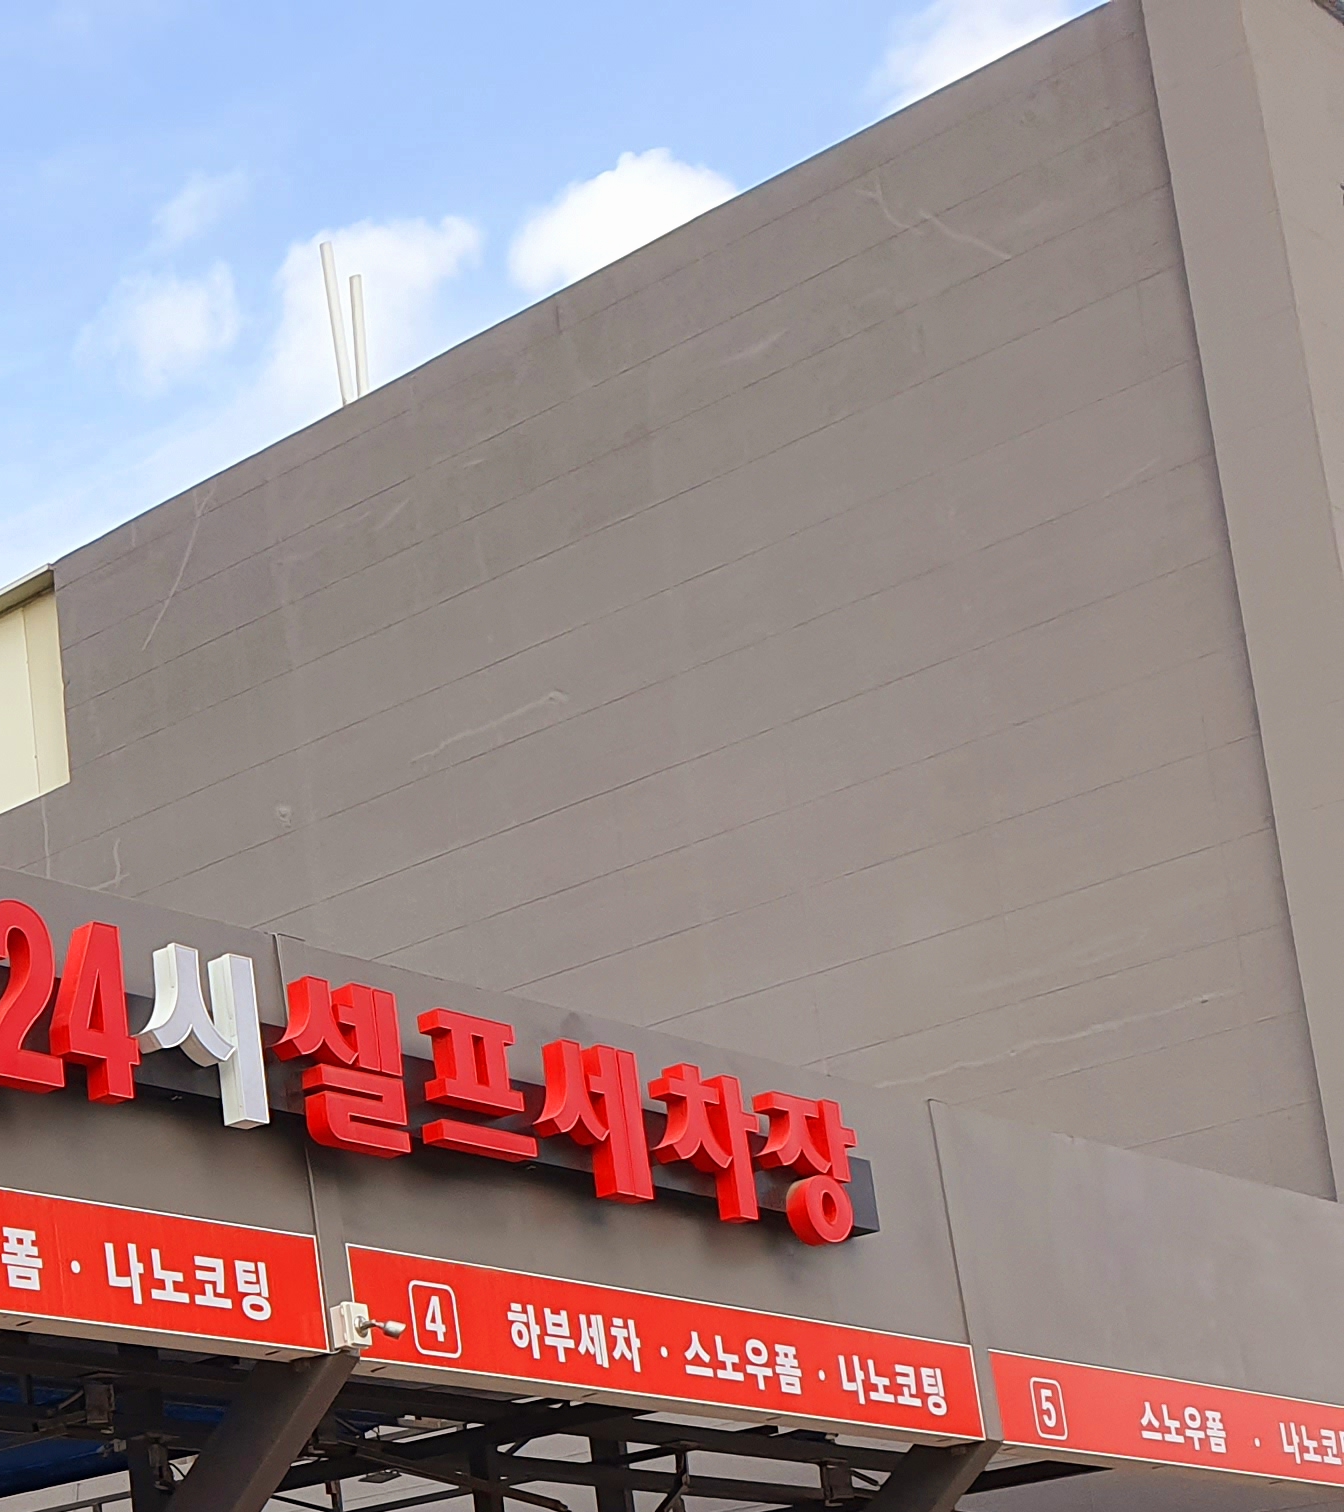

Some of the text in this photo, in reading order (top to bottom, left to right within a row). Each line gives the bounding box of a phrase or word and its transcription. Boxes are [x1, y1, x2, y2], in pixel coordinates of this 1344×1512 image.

[105, 1242, 271, 1321] 나노코팅
[425, 1296, 948, 1416] 4 하부세차 스노우폼 나노코팅
[1042, 1388, 1058, 1428] 5
[1140, 1401, 1227, 1454] 스노우폼
